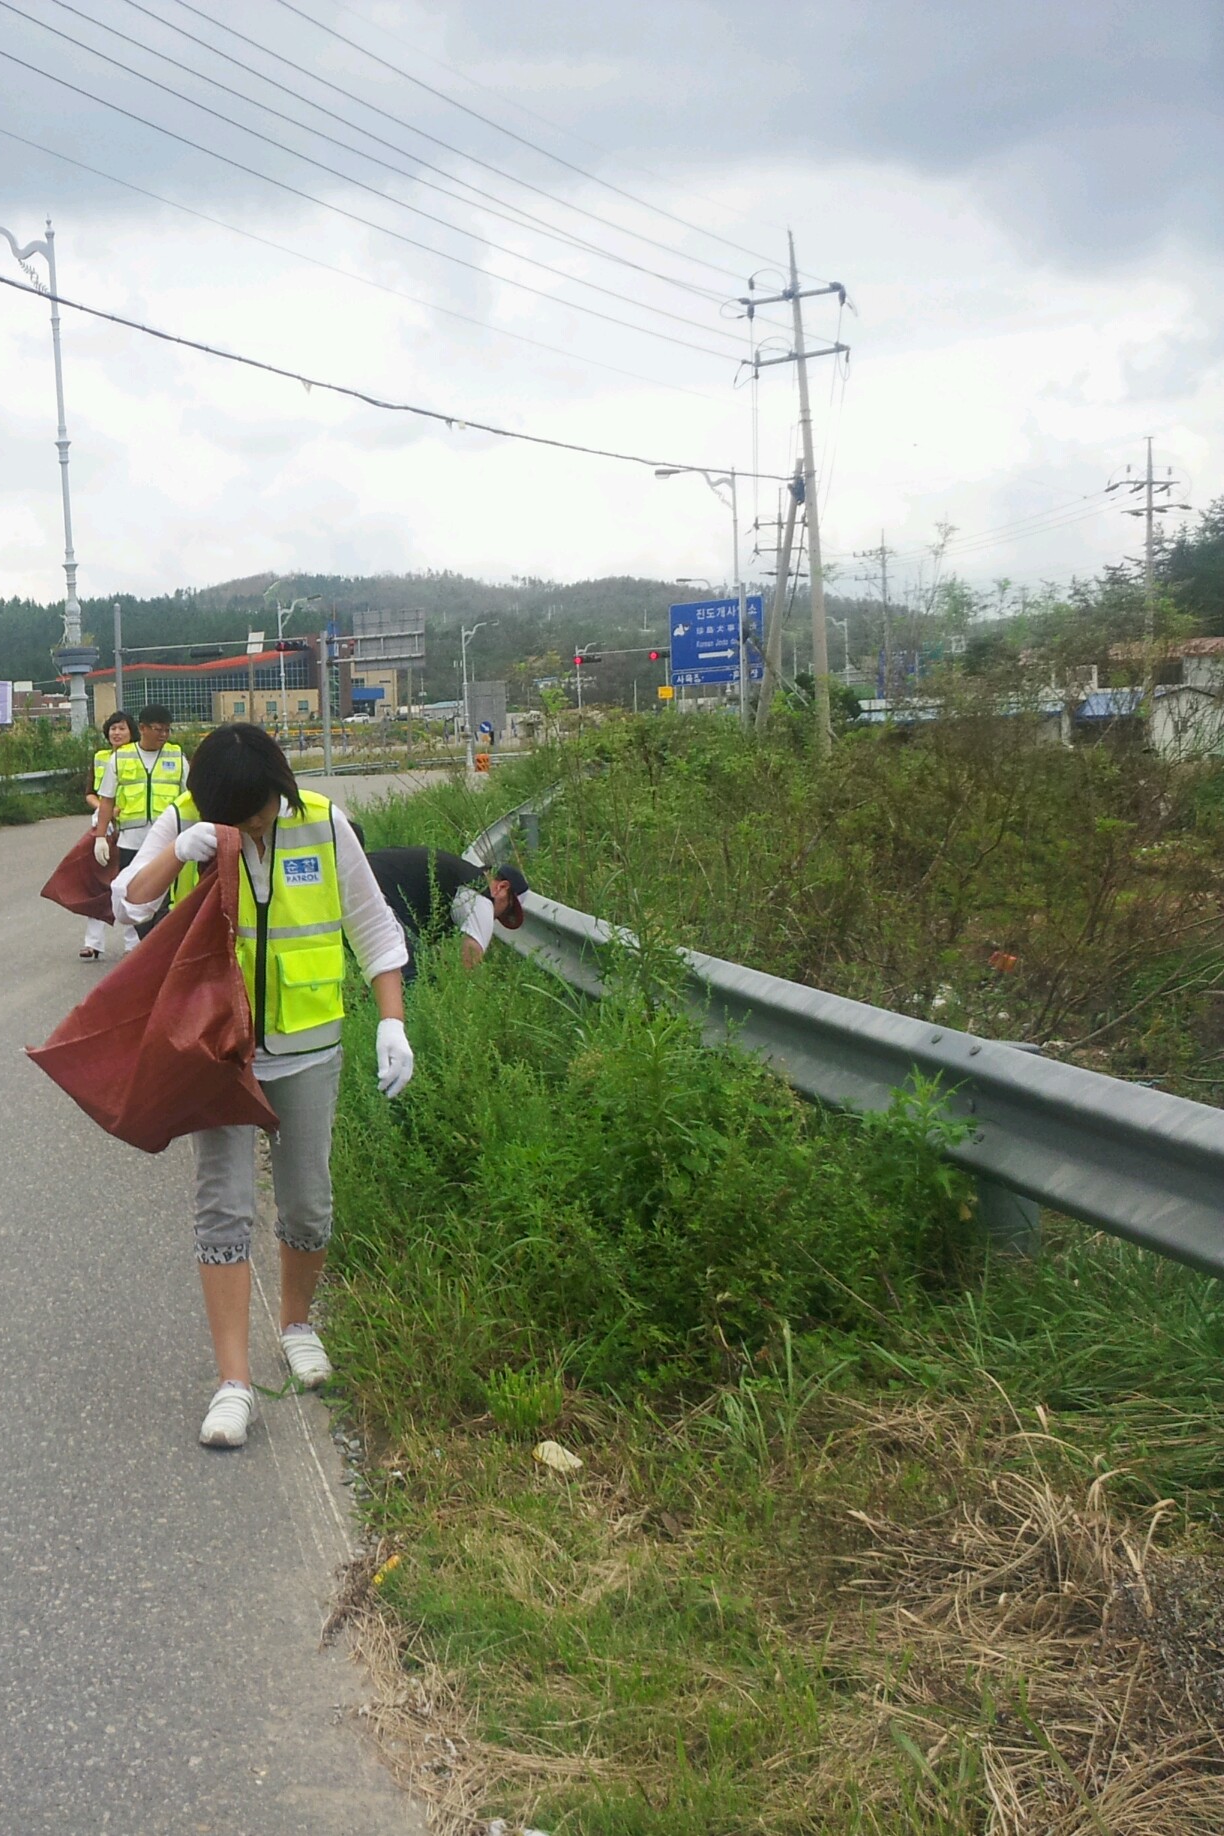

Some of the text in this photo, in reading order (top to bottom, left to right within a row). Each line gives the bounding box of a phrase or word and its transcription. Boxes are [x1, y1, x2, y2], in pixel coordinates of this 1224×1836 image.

[696, 603, 757, 620] 진도개사소
[286, 858, 316, 874] 순찰
[286, 874, 319, 883] PATROL
